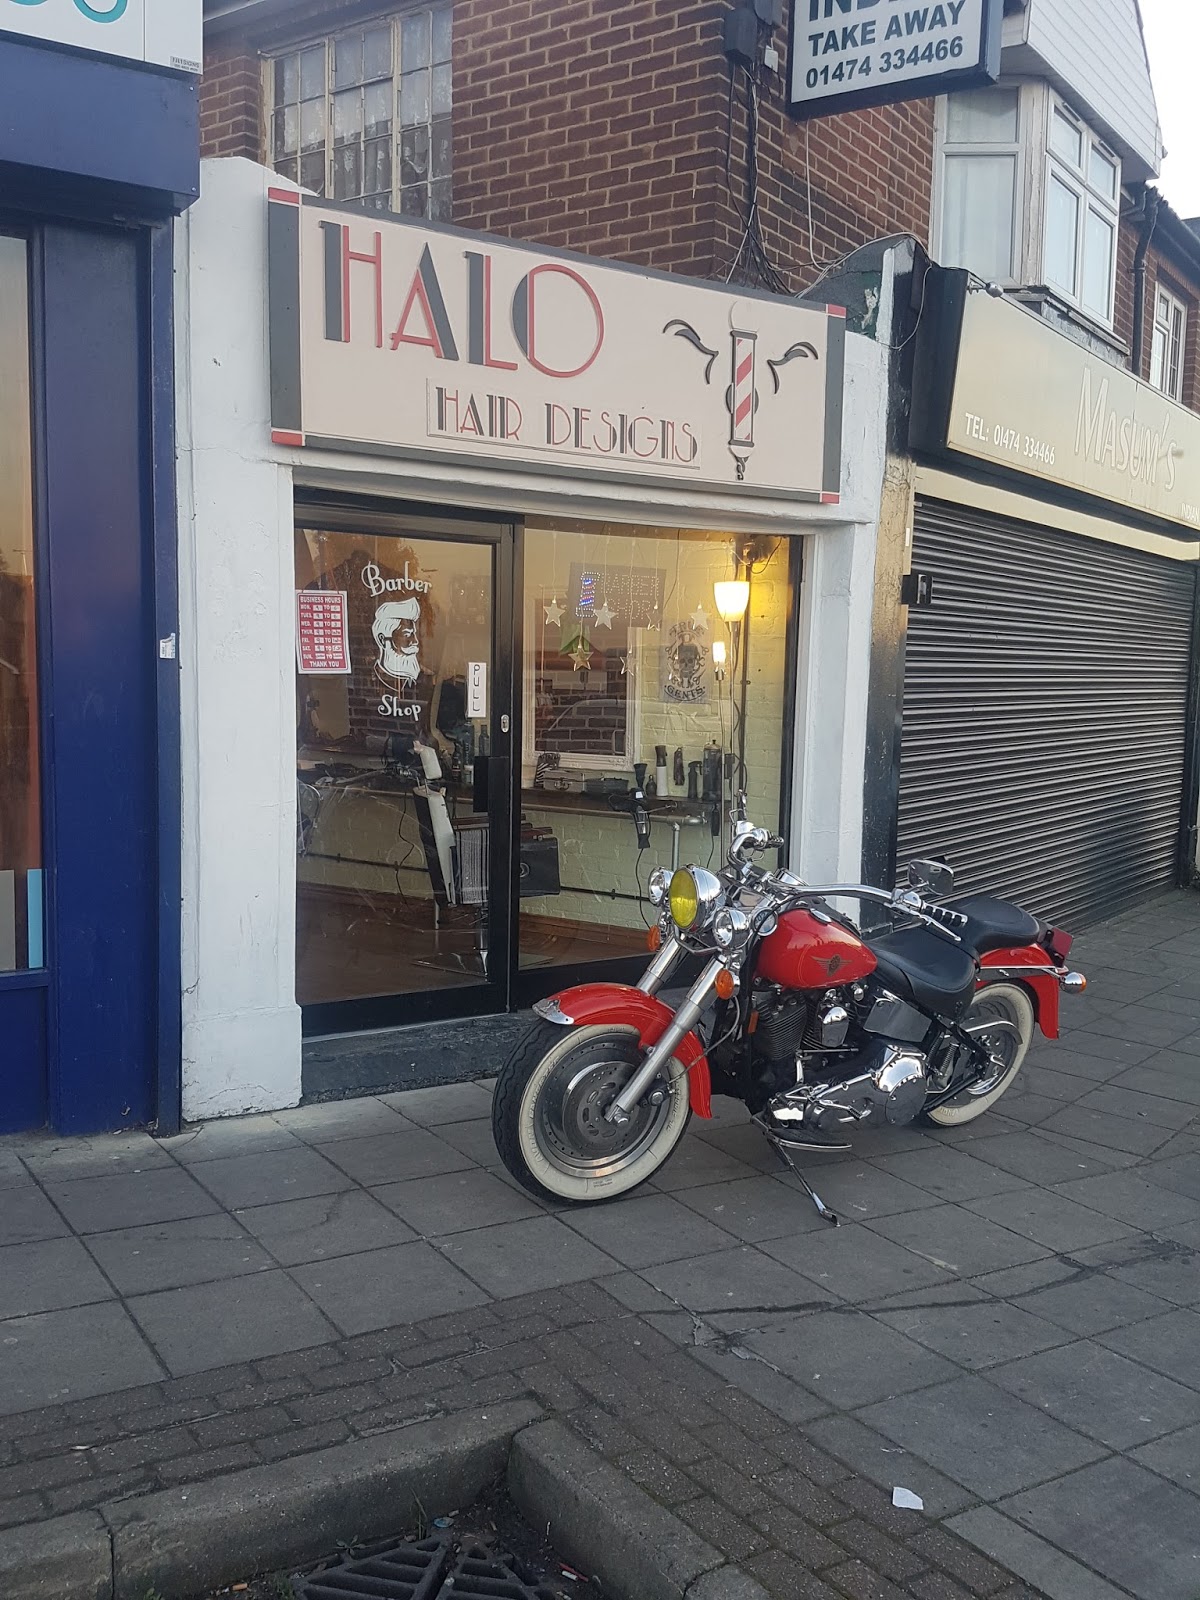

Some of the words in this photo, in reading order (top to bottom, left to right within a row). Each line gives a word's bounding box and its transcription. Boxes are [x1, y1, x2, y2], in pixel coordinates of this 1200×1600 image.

[808, 20, 876, 57] TAKE
[884, 0, 965, 41] AWAY
[806, 56, 871, 88] 01474
[879, 36, 963, 73] 334466
[318, 220, 605, 378] HALO
[435, 386, 523, 441] HAIR
[545, 402, 698, 462] DESIGNS
[965, 412, 989, 442] TEL:
[993, 424, 1020, 453] 01474
[1023, 436, 1055, 465] 334466
[361, 561, 432, 597] Barber
[377, 694, 422, 721] Shop
[472, 664, 480, 711] PULL
[667, 685, 703, 699] GENTS
